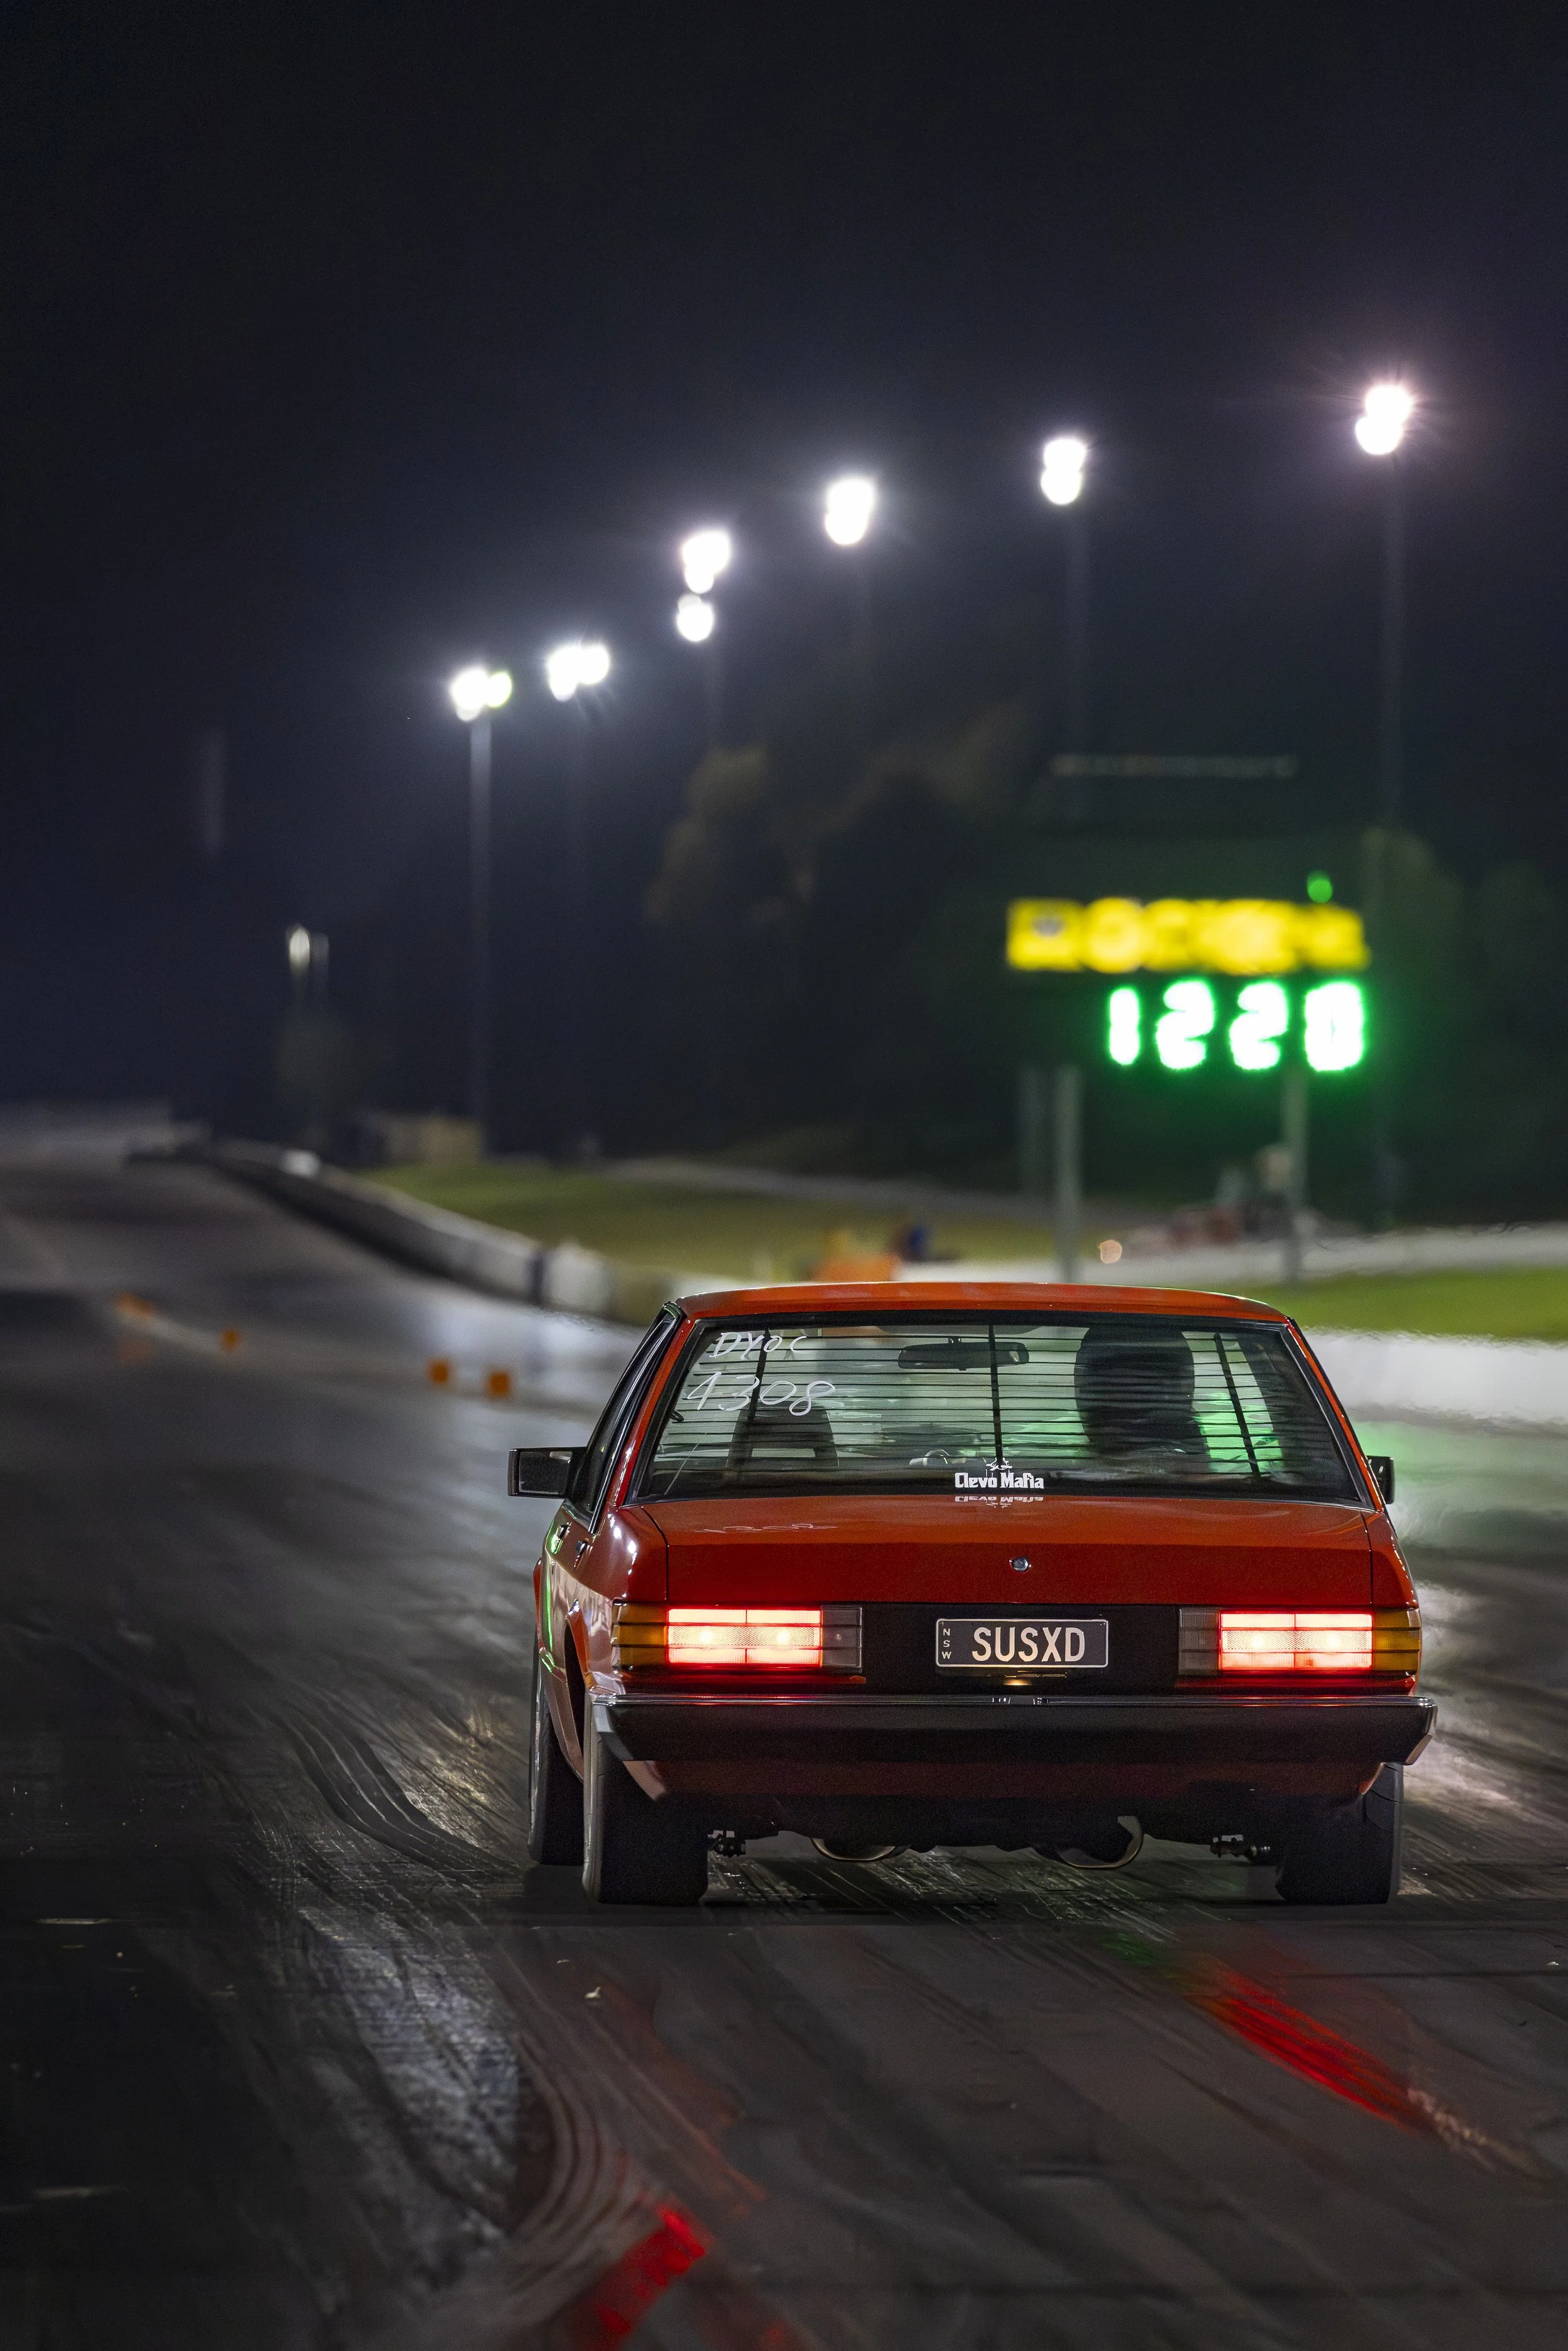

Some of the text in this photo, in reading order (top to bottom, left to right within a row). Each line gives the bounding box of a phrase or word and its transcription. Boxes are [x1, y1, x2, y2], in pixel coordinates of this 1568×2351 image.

[687, 1372, 836, 1416] 4308
[955, 1472, 1044, 1489] Clevo Mafia
[941, 1628, 952, 1660] NSW
[972, 1627, 1085, 1662] SUSXD
